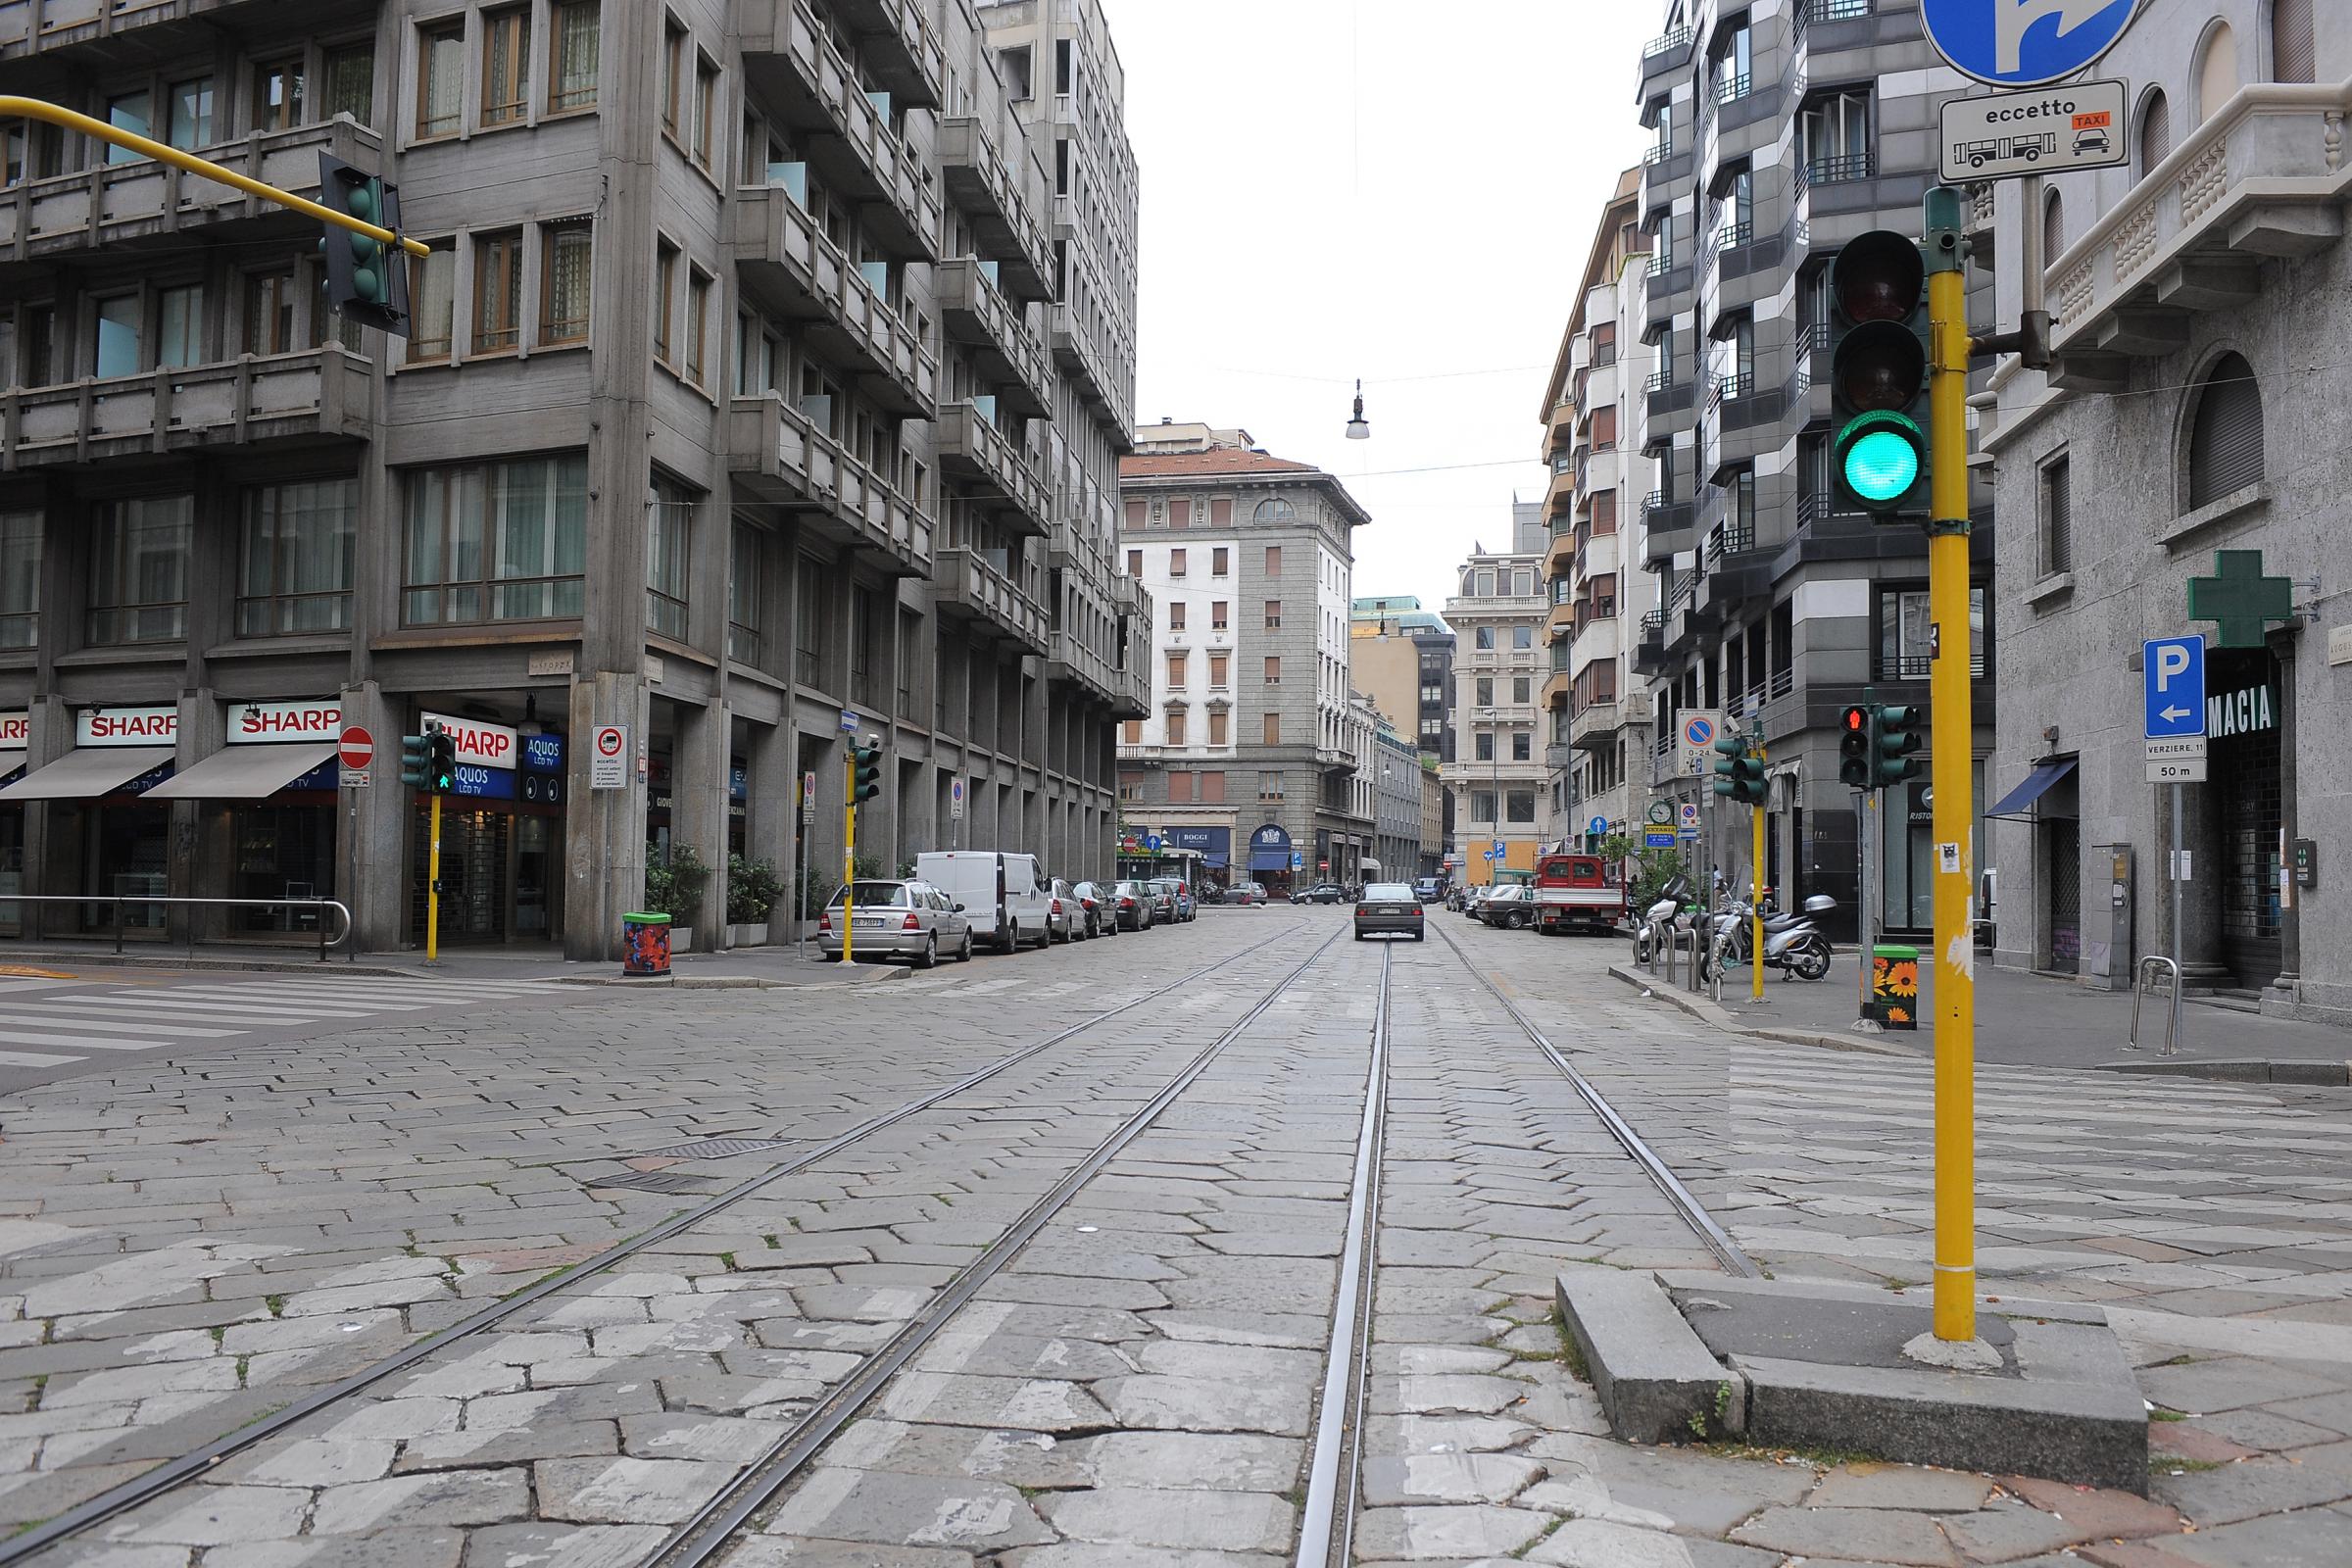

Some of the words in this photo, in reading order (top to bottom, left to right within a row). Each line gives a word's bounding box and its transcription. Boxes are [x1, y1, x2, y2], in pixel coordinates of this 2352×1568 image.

[1985, 99, 2076, 123] eccetto
[2075, 115, 2105, 126] TAXI
[2156, 644, 2190, 693] P
[2207, 684, 2272, 739] MACIA
[242, 709, 342, 734] SHARP
[441, 724, 510, 758] HARP
[527, 739, 560, 757] AQUOS
[533, 757, 545, 765] LCD
[2161, 766, 2177, 776] 50
[2180, 767, 2190, 776] m
[459, 785, 471, 794] LCD
[473, 786, 482, 795] TV
[656, 796, 672, 808] GIOVE
[1909, 811, 1934, 821] RISTO
